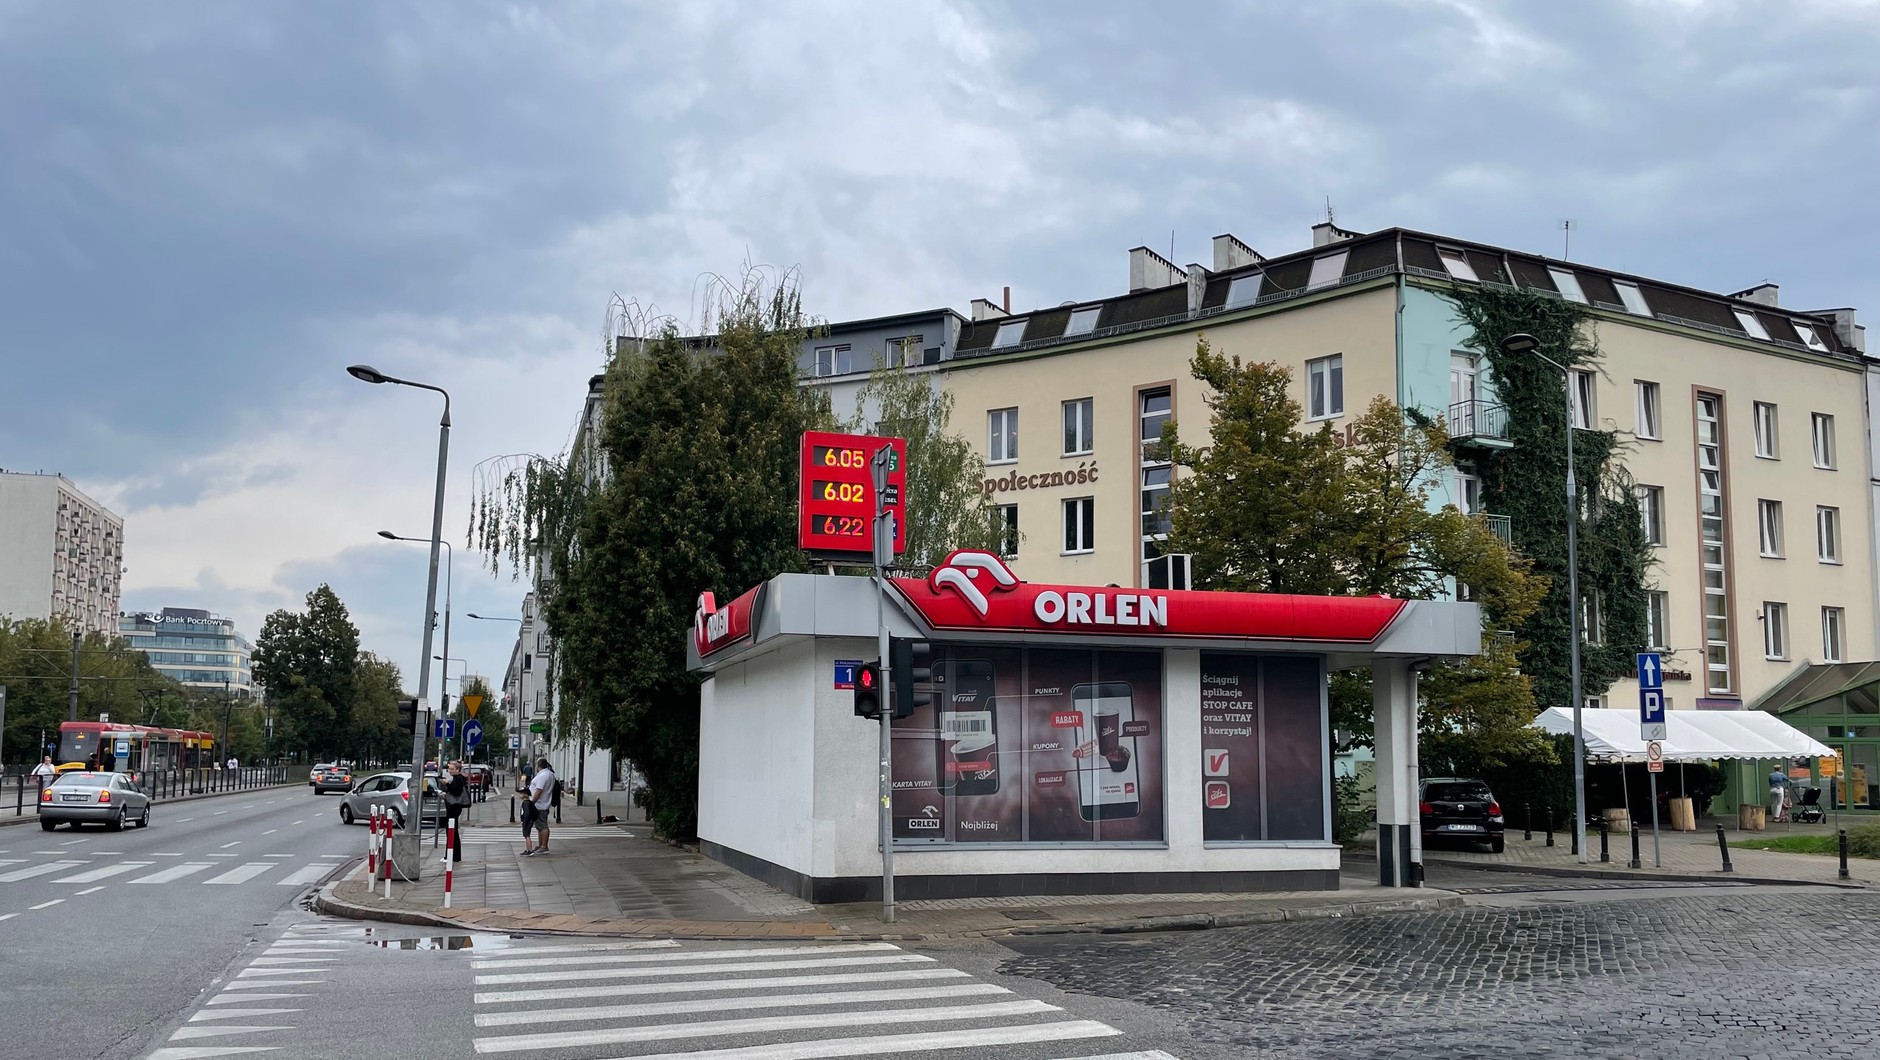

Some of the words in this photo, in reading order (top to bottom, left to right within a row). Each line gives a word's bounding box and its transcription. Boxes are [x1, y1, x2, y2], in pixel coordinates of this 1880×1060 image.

[825, 448, 865, 469] 6.05
[824, 482, 864, 503] 6.02
[823, 516, 863, 536] 6.22
[1034, 590, 1167, 627] ORLEN
[165, 615, 185, 624] Bank
[187, 616, 224, 626] Pocztowy
[846, 668, 852, 682] 1
[1202, 673, 1239, 686] Ściągnij
[1034, 687, 1060, 695] PUNKTY
[951, 693, 978, 703] VITAY
[1203, 701, 1228, 710] STOP
[1229, 701, 1253, 710] CAFE
[1645, 692, 1660, 719] P
[1055, 715, 1079, 725] RABATY
[1203, 714, 1223, 722] oraz
[1224, 713, 1252, 722] VITAY
[1203, 726, 1207, 735] i
[1208, 726, 1252, 737] korzystaj!
[1032, 742, 1060, 750] KUPONY
[914, 780, 933, 788] VITAY
[910, 820, 938, 828] ORLEN
[960, 821, 999, 832] Najbliżej
